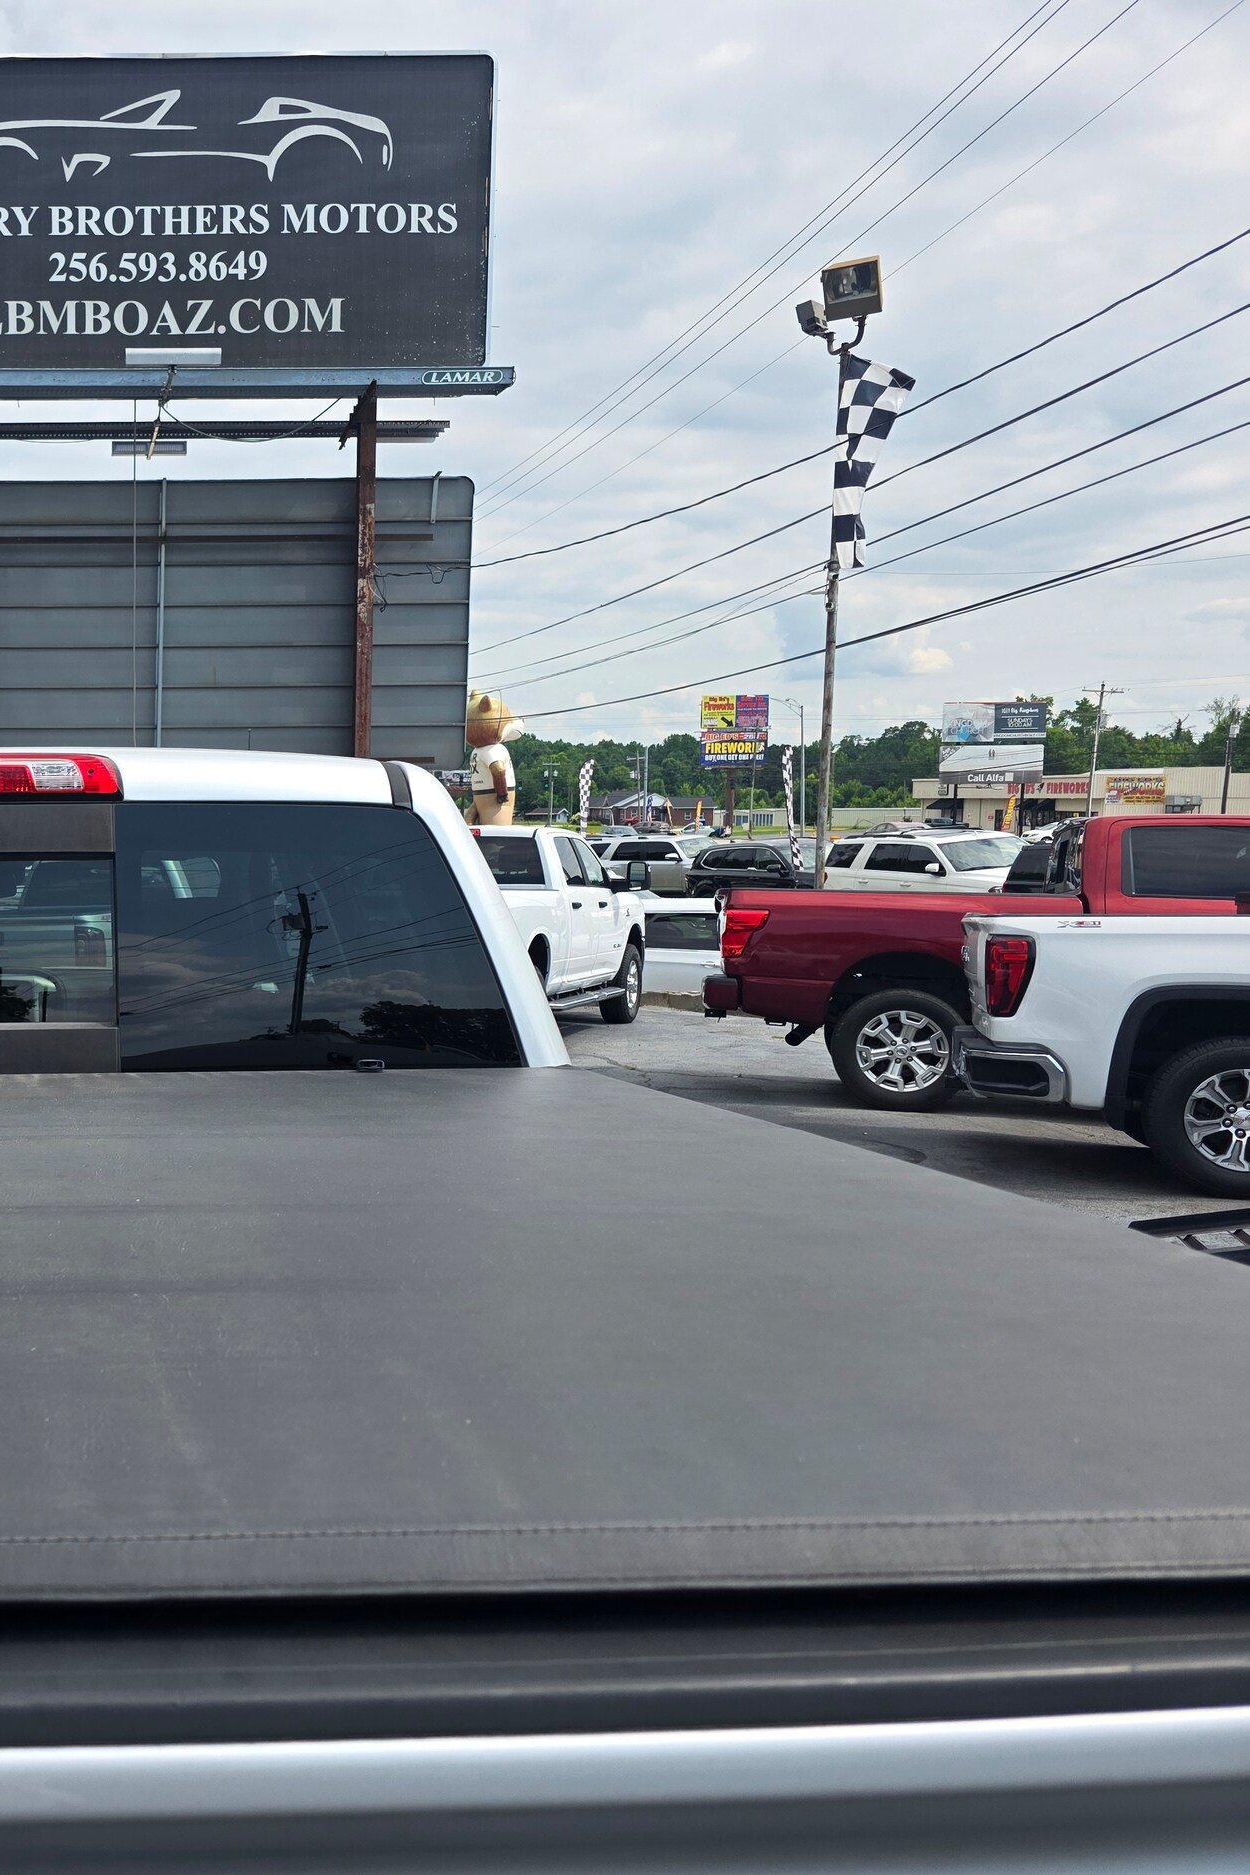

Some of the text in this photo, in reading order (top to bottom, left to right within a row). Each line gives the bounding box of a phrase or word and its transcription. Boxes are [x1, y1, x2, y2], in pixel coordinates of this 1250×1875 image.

[48, 204, 270, 237] BROTHERS
[280, 203, 458, 234] MOTORS
[48, 251, 268, 283] 256.593.8649
[430, 371, 495, 383] LAMAR
[967, 774, 1004, 782] Call Alfa
[1008, 783, 1019, 794] BIG
